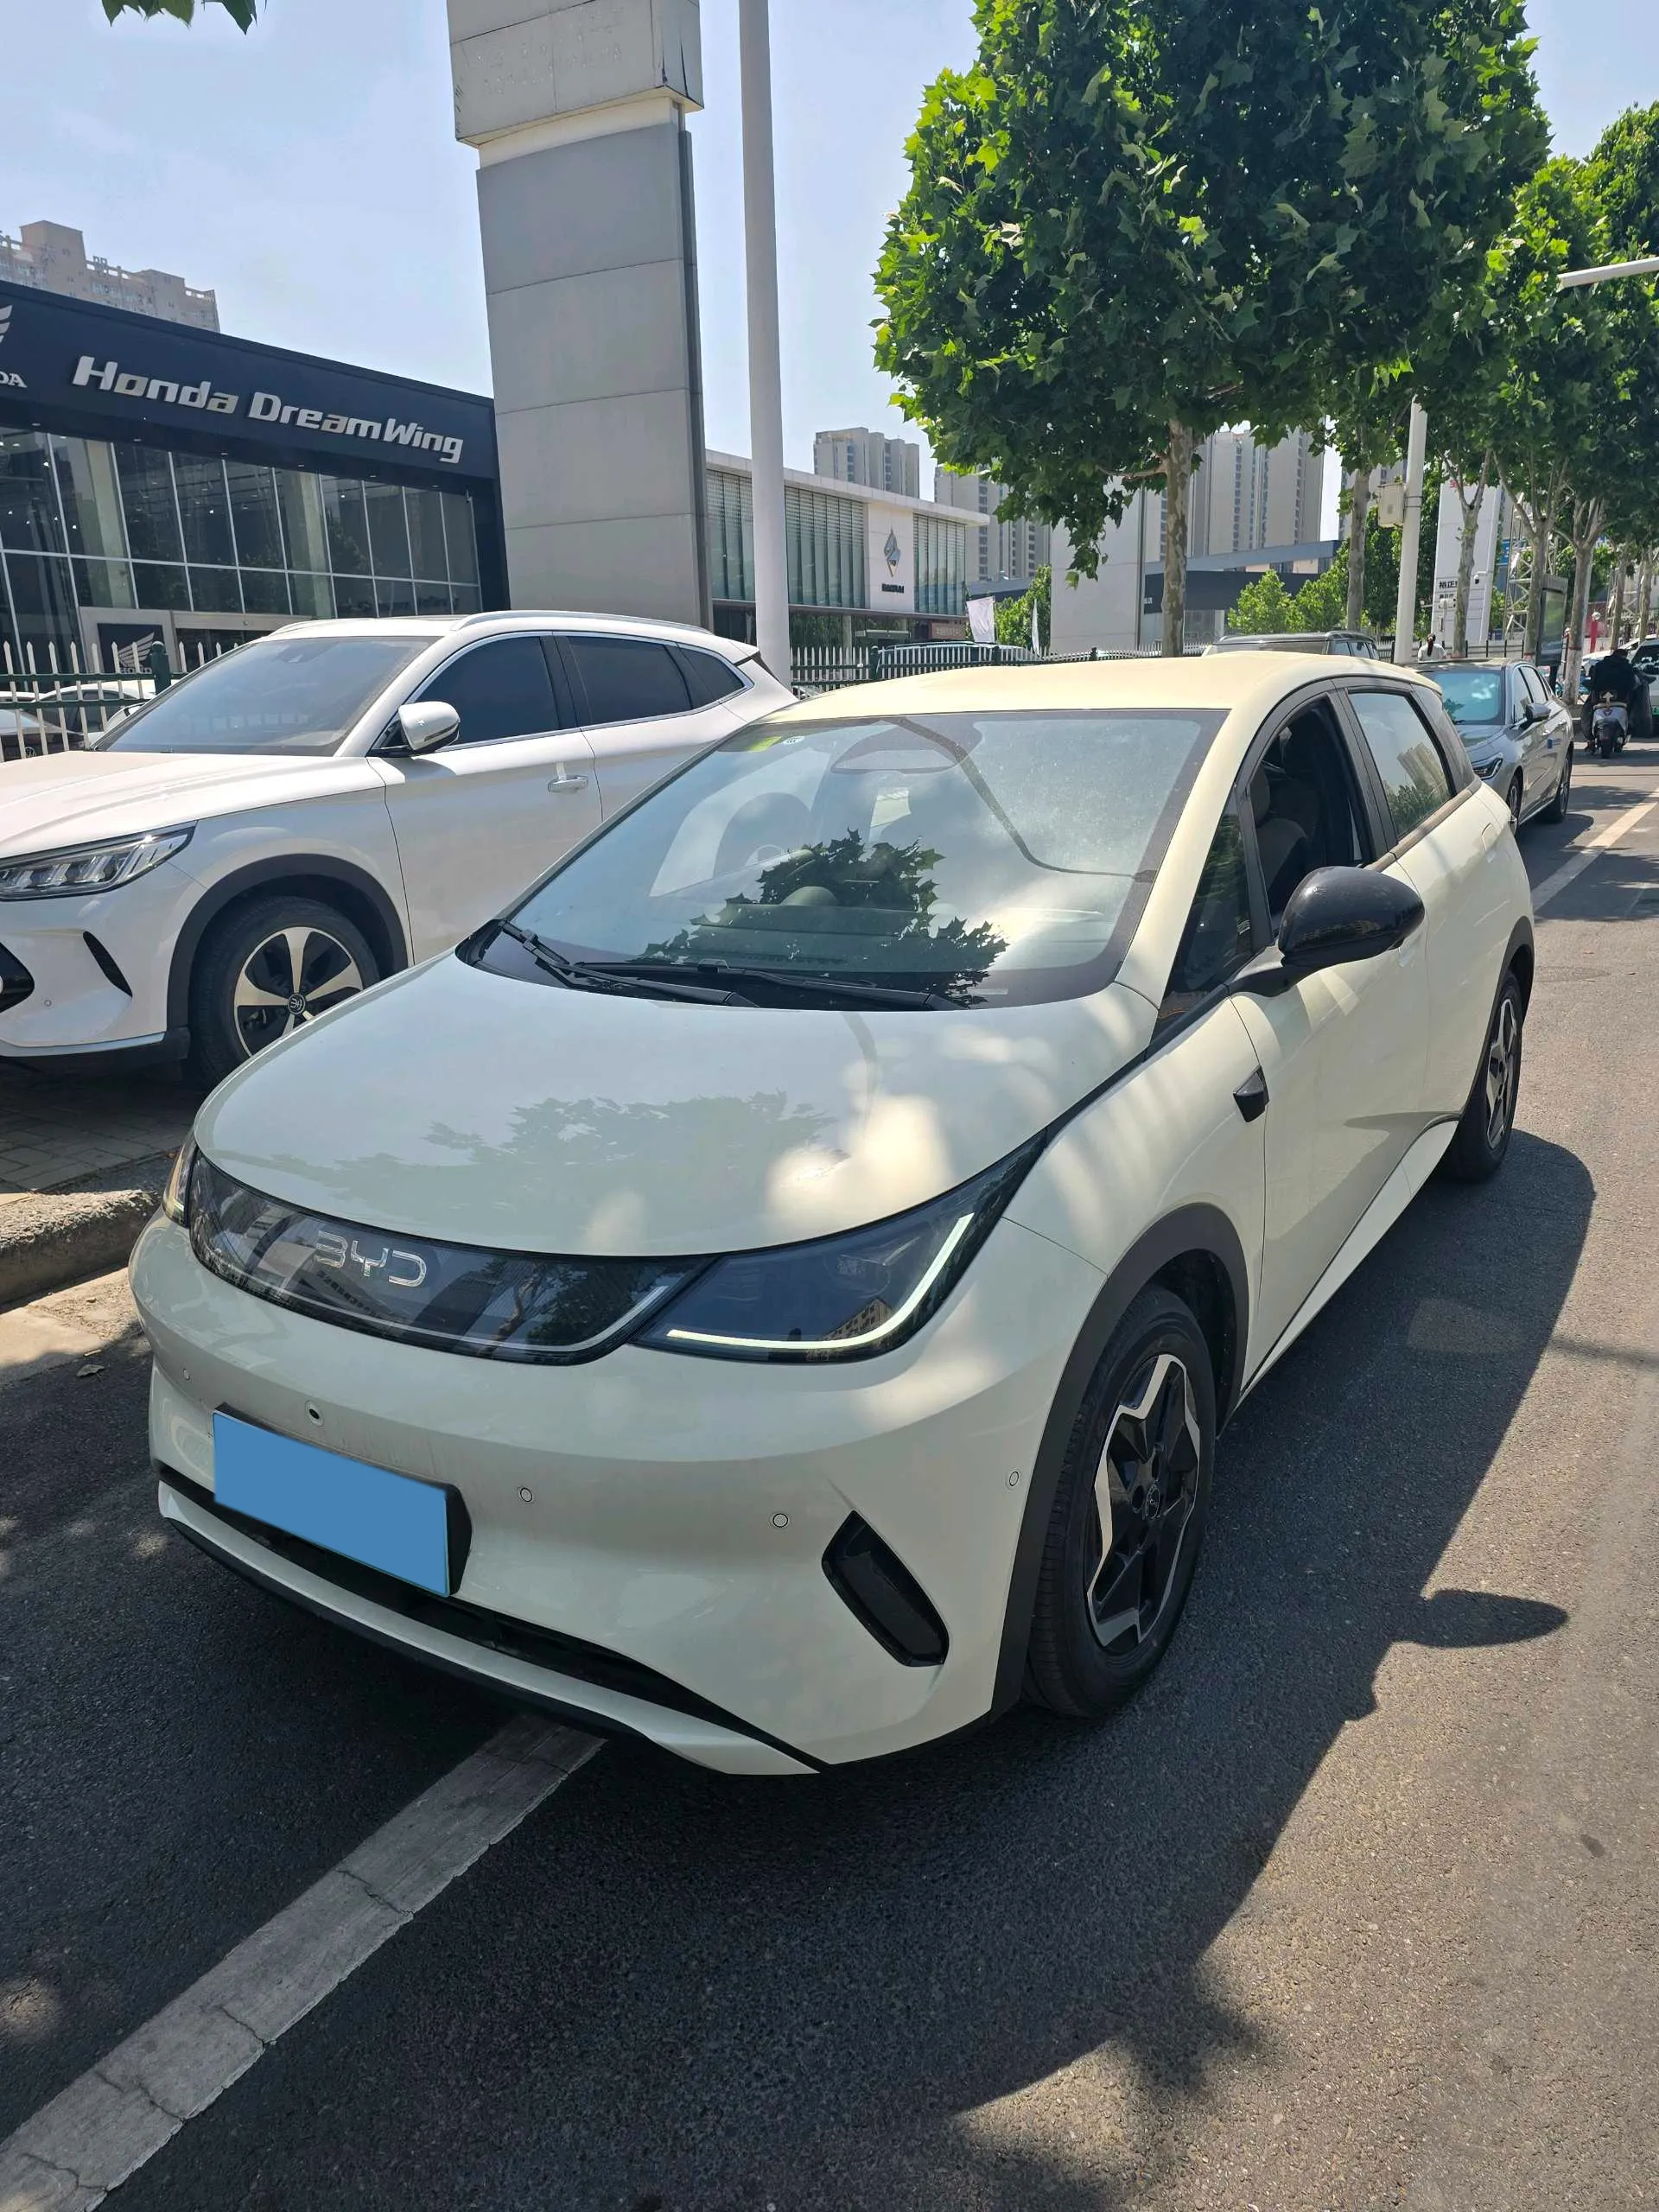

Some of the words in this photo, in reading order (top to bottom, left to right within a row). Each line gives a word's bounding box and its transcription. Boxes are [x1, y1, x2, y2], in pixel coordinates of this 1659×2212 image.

[73, 355, 239, 414] Honda
[248, 391, 464, 464] DreamWing
[315, 1230, 427, 1287] BYD
